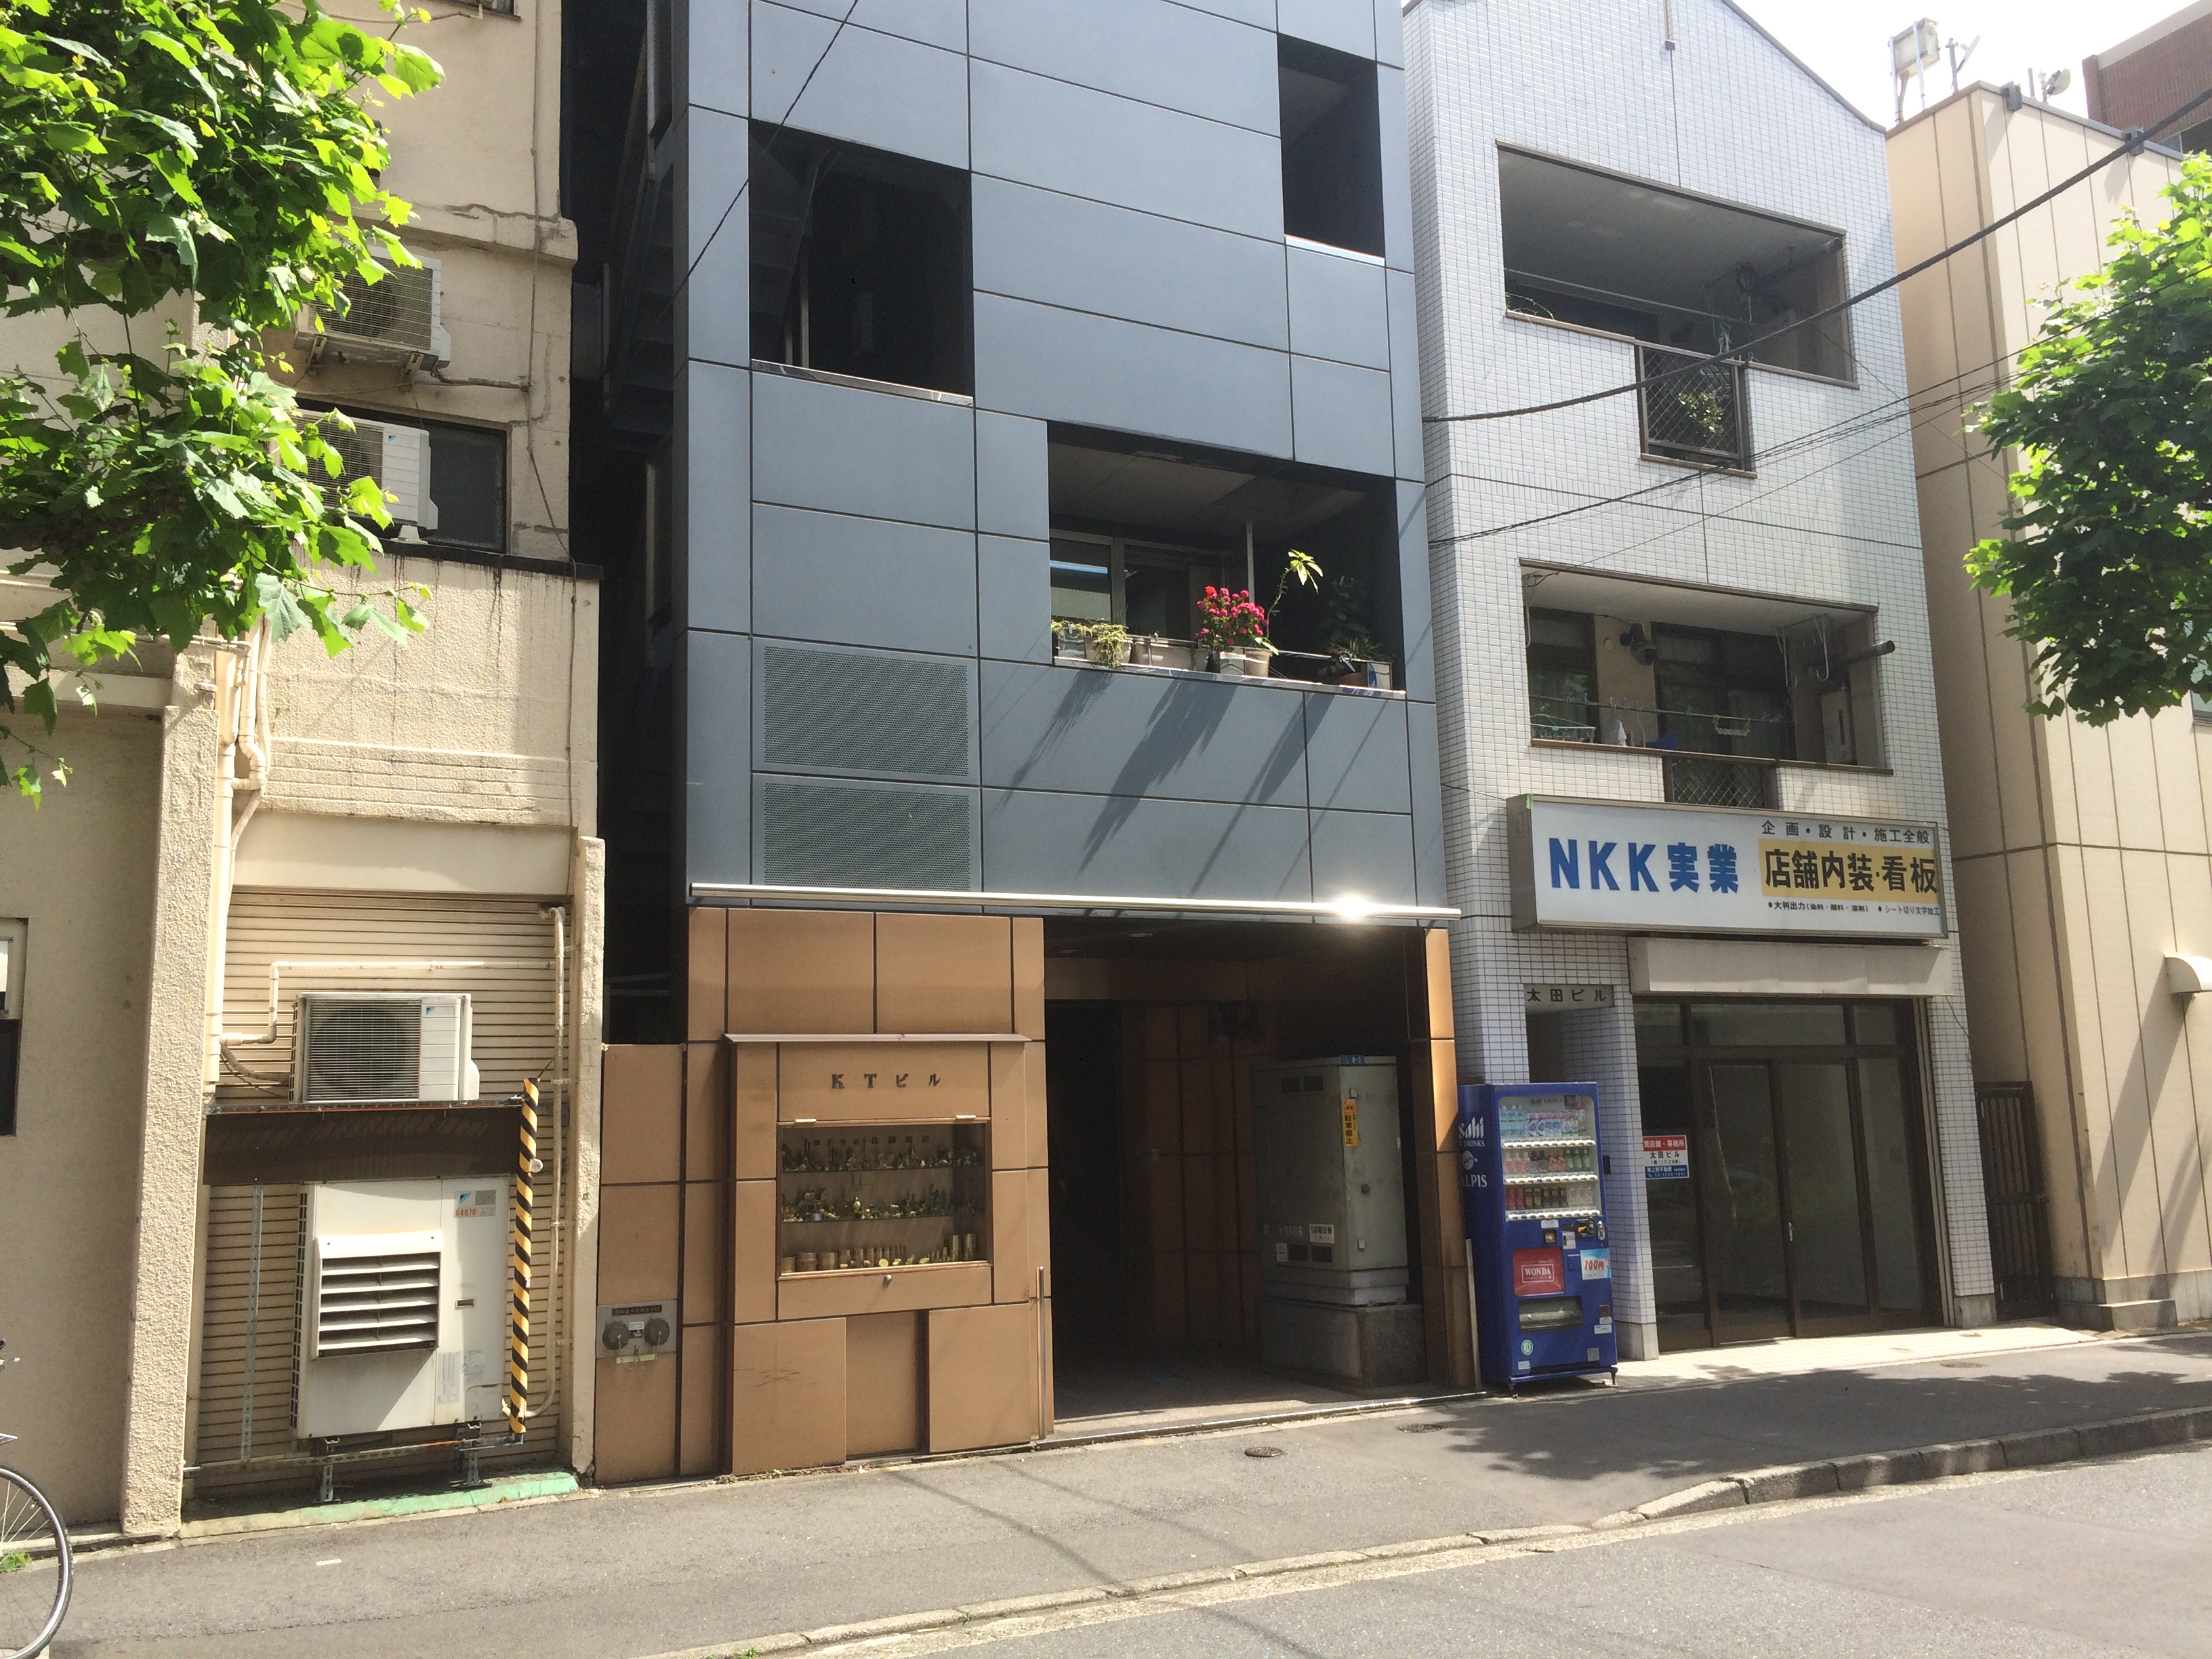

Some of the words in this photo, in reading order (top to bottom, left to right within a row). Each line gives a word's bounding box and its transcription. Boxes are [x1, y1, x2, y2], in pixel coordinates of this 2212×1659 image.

[1549, 838, 1739, 894] NKK実業
[1526, 987, 1607, 1002] 太田ビル
[1458, 1116, 1484, 1139] sahi
[1650, 1151, 1681, 1159] 太田ビル
[1465, 1174, 1488, 1188] LPIS
[1524, 1267, 1552, 1277] WONDA
